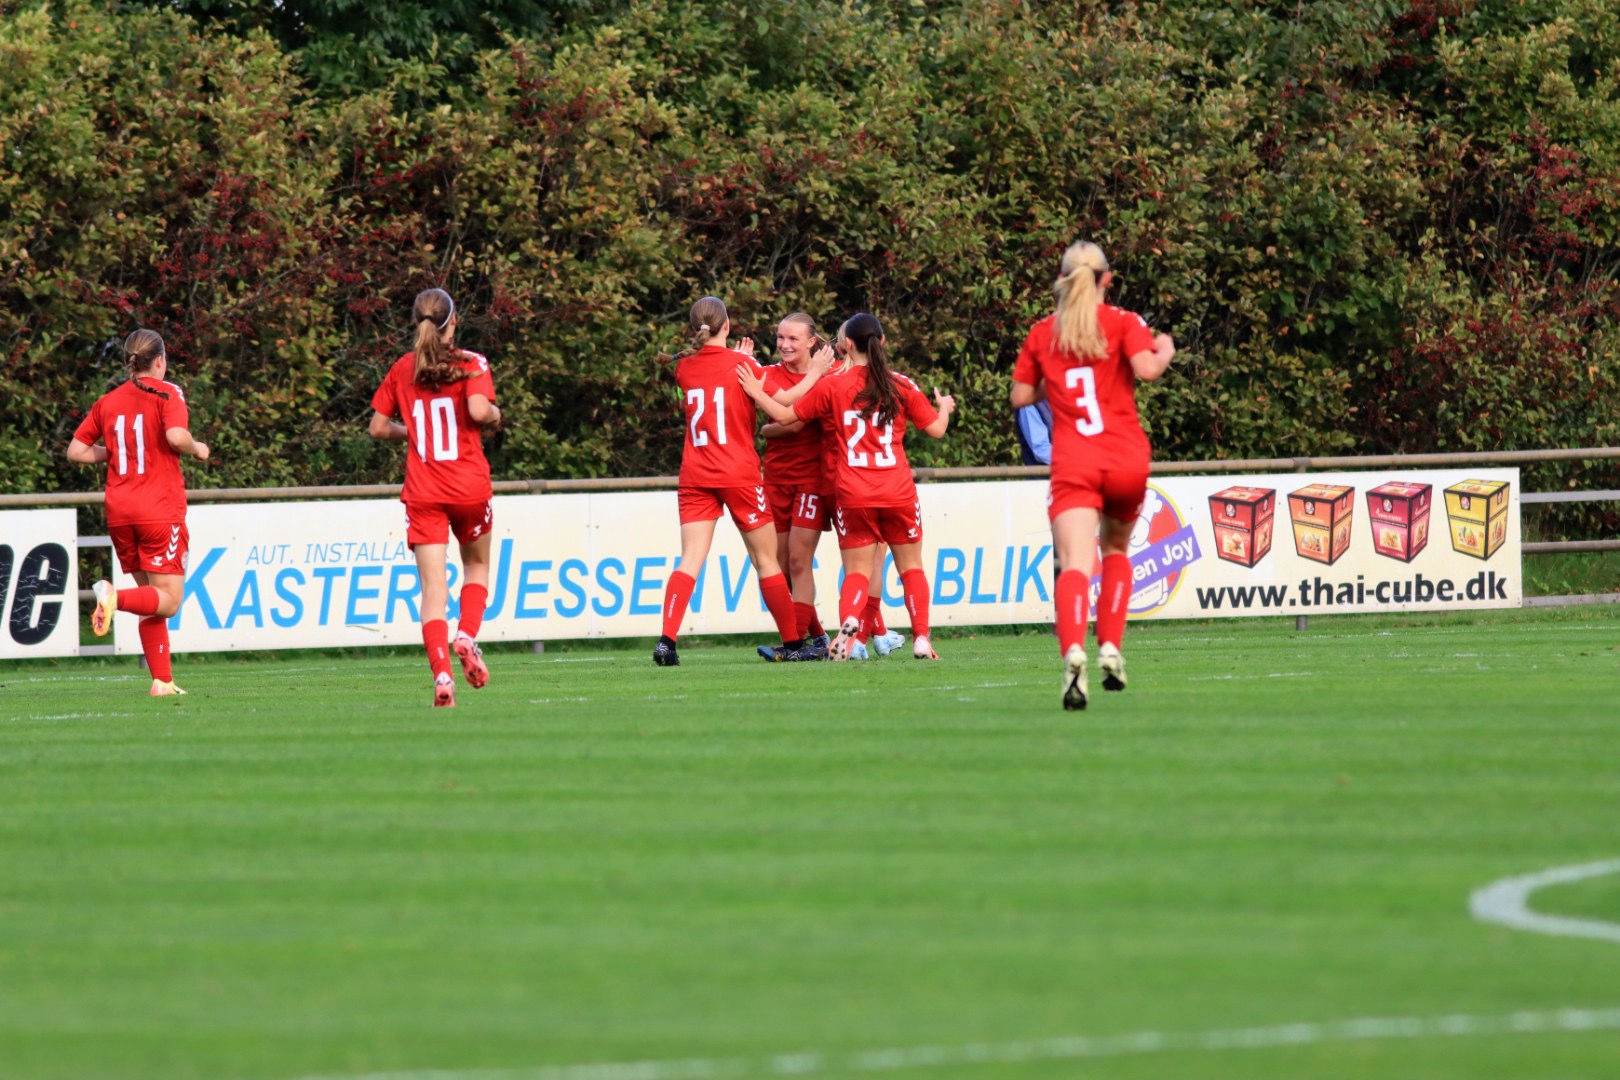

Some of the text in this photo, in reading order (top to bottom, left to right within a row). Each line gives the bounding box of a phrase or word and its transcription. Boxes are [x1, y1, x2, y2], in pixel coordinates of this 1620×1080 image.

[412, 397, 459, 463] 10
[687, 386, 727, 447] 21
[1065, 366, 1104, 437] 3
[114, 413, 145, 475] 11
[843, 410, 897, 467] 23
[798, 492, 819, 520] 15
[246, 541, 450, 565] AUT. INSTALLA
[932, 545, 1053, 605] BLIK
[1162, 536, 1195, 566] Joy
[1196, 571, 1508, 610] www.thai-cube.dk
